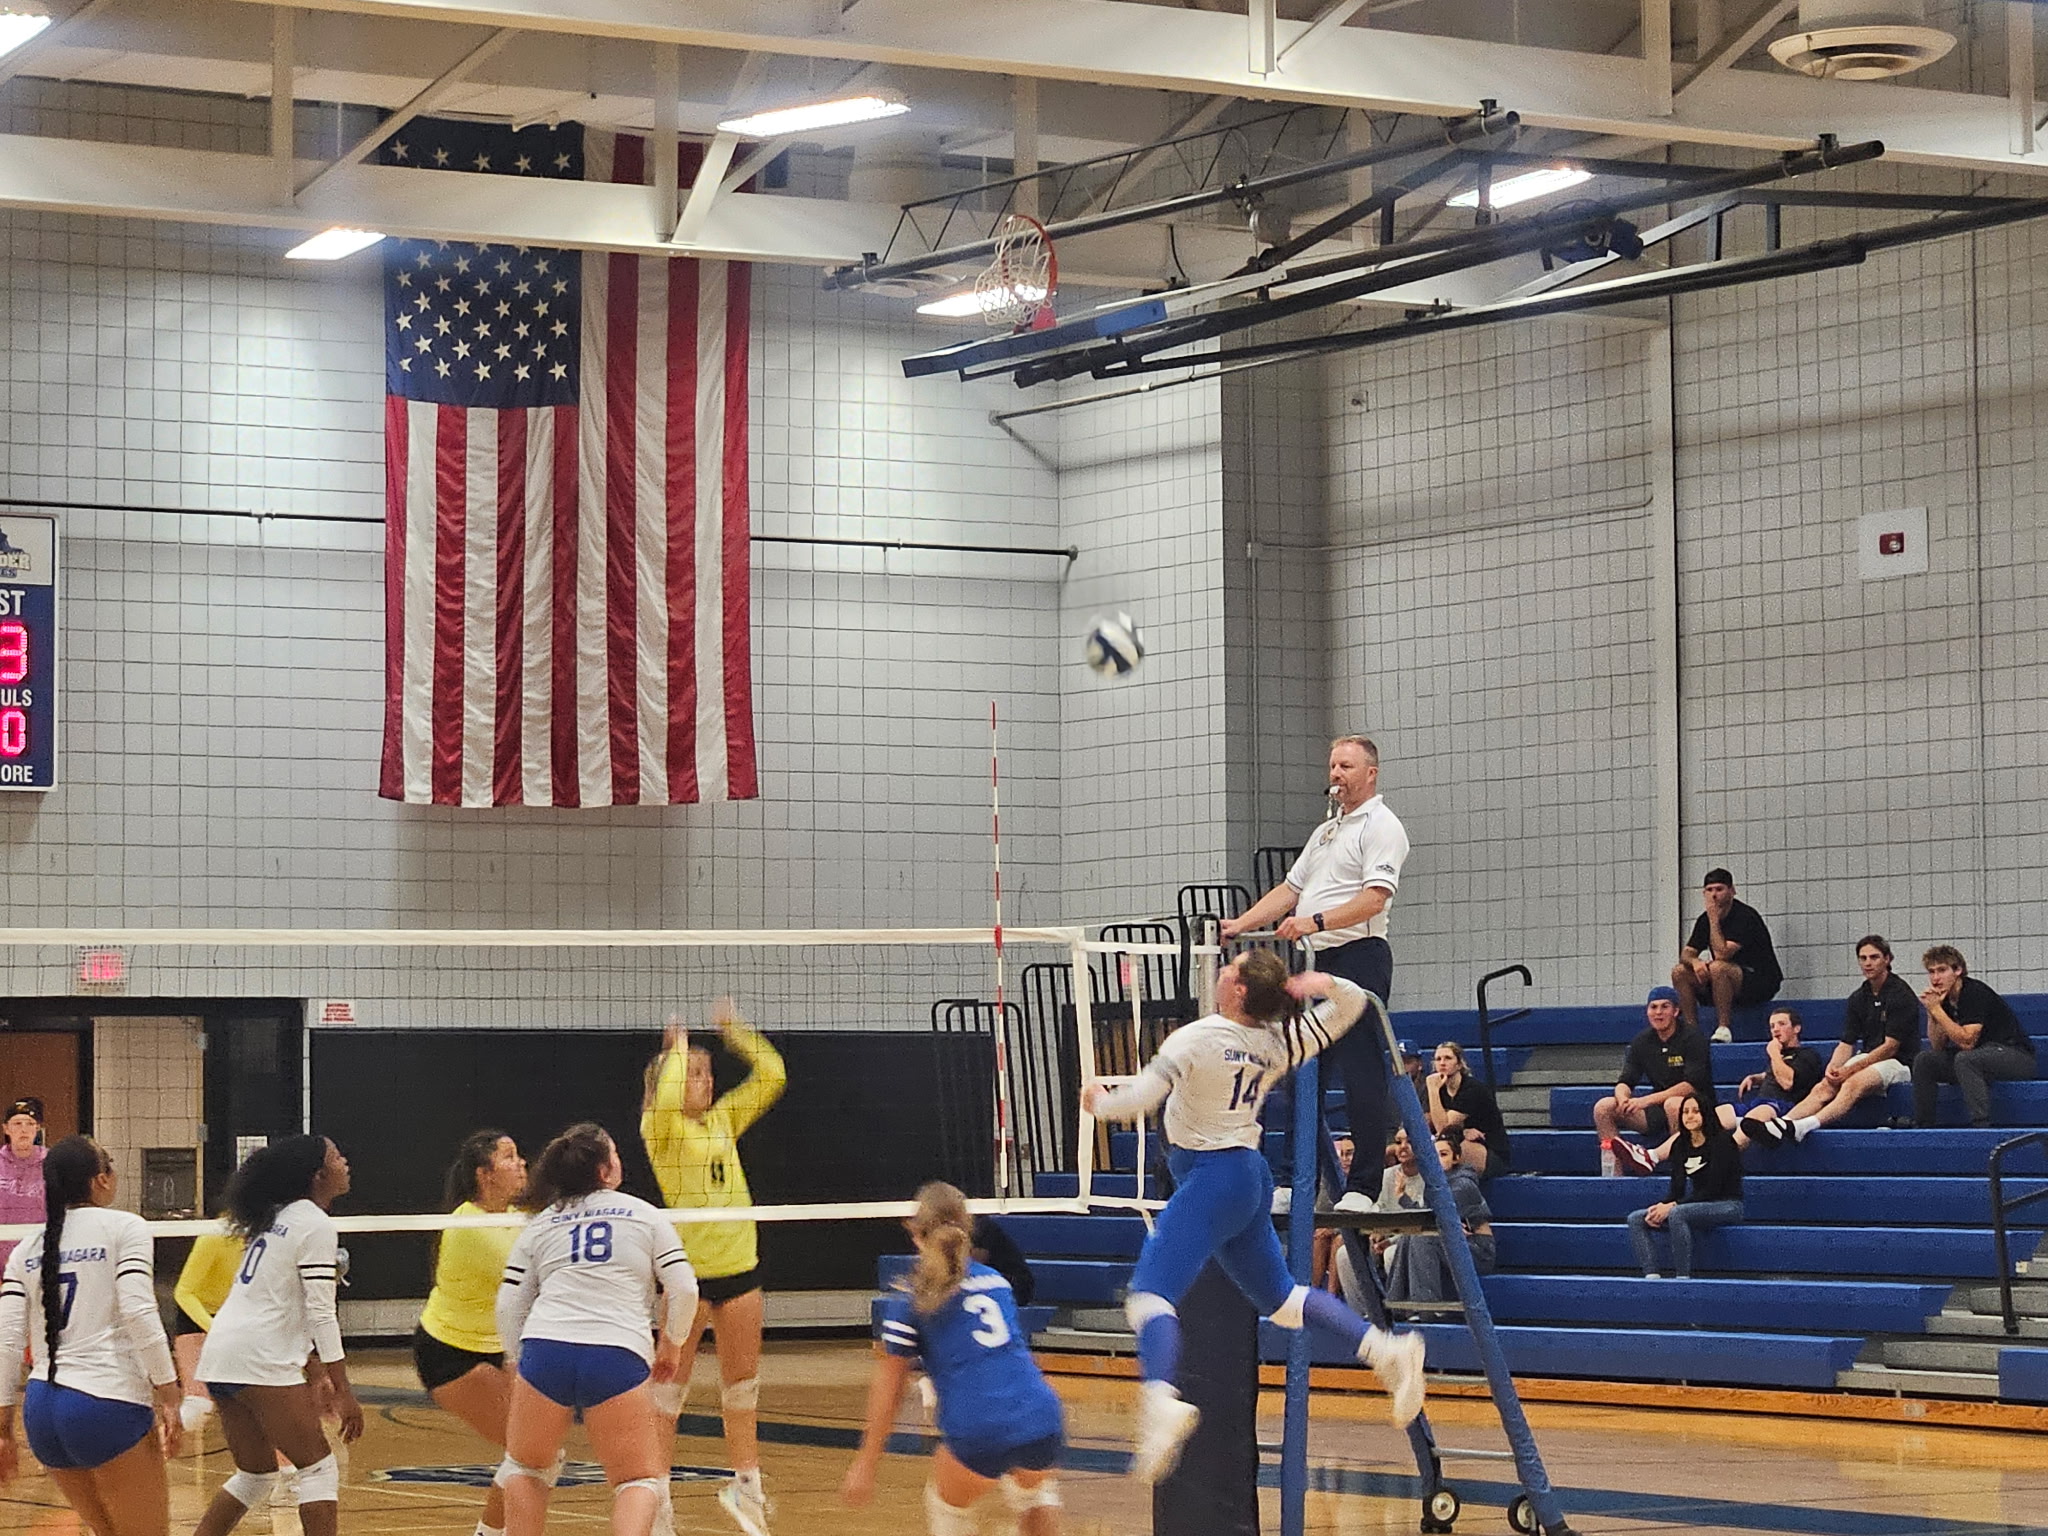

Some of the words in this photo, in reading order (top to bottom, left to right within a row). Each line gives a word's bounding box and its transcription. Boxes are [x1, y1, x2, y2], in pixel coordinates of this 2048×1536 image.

[2, 710, 26, 754] 0
[1, 764, 33, 783] ORE
[1229, 1066, 1265, 1110] 14
[583, 1207, 634, 1218] NIAGARA
[568, 1221, 613, 1263] 18
[961, 1293, 1012, 1349] 3
